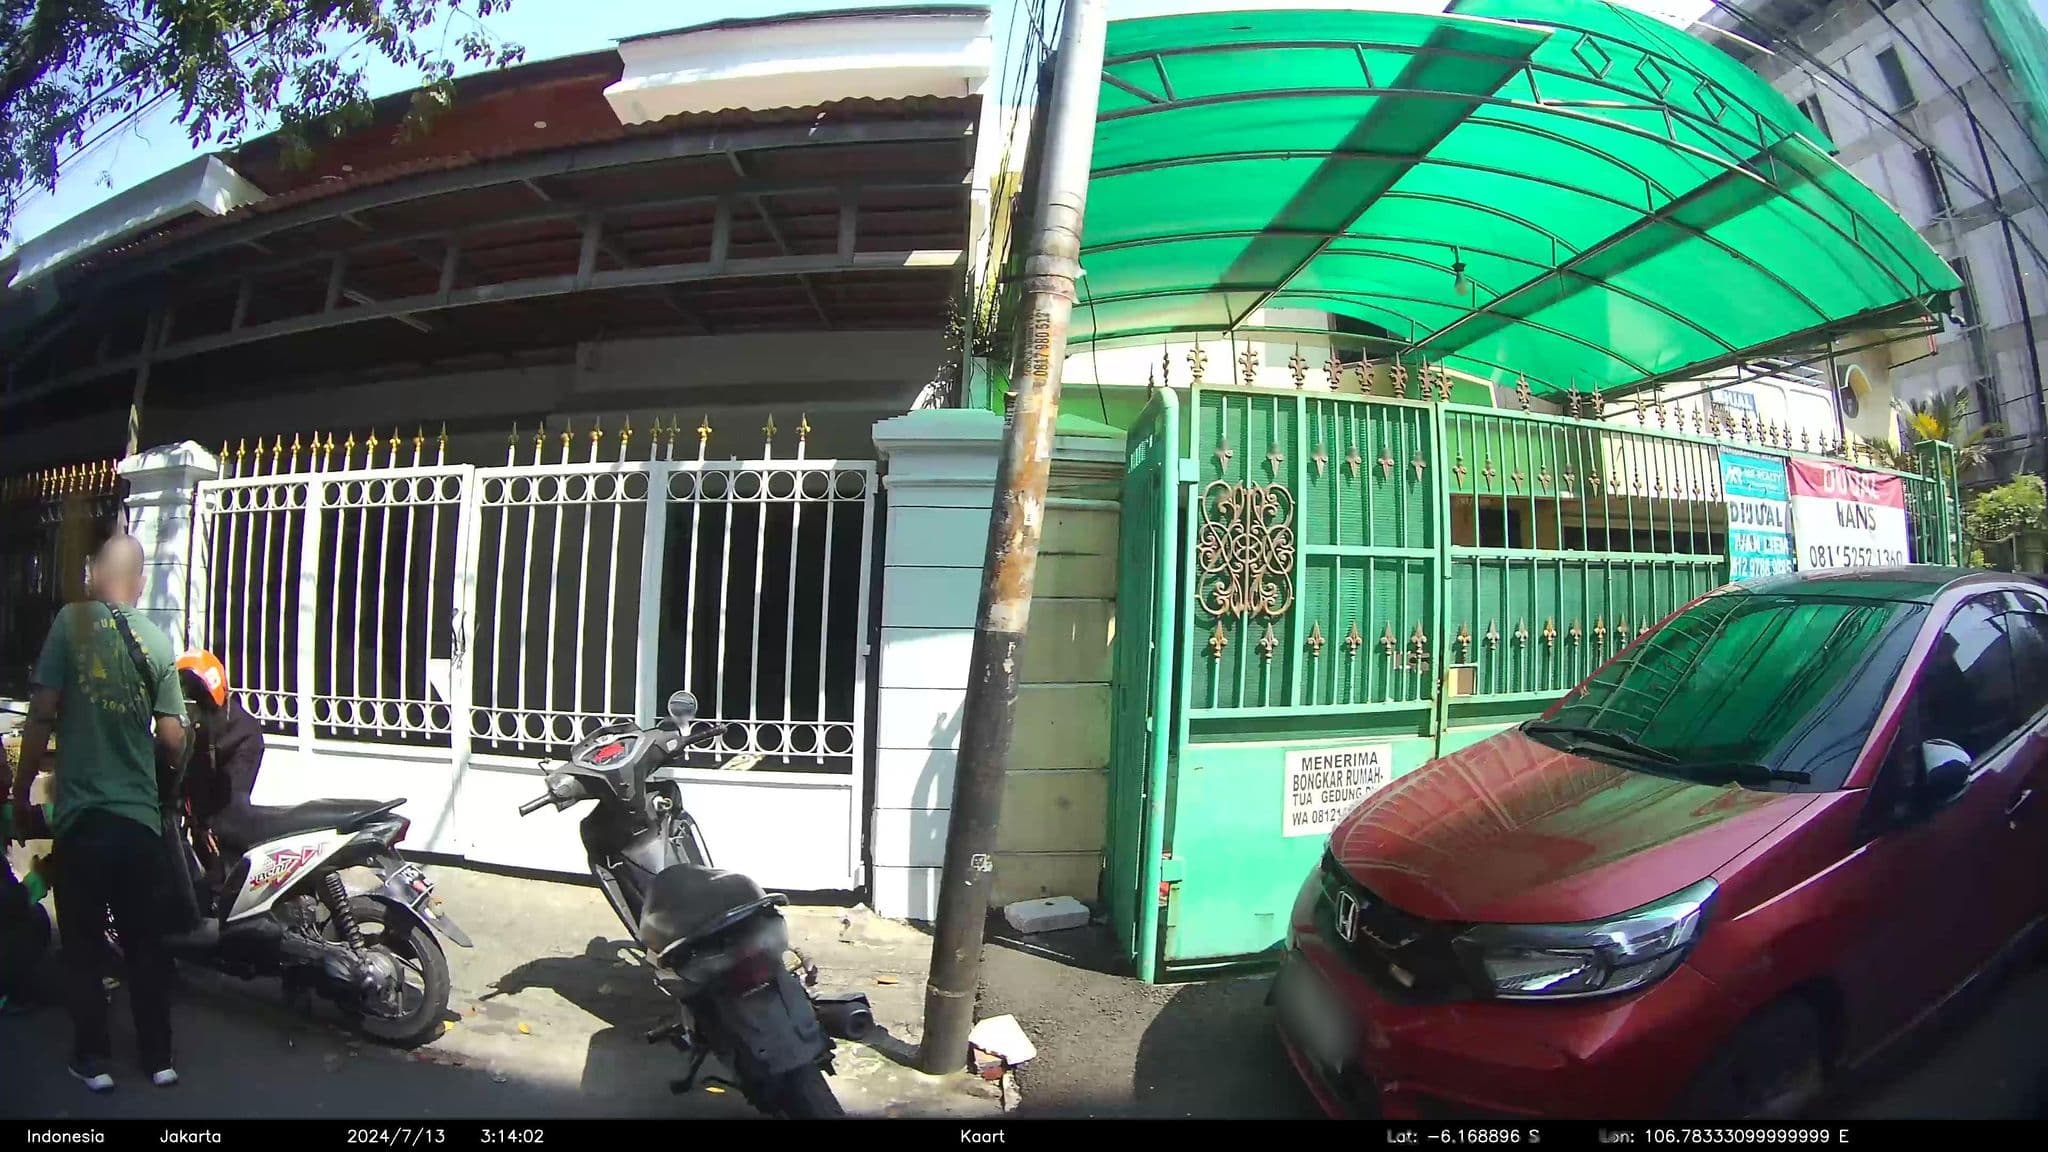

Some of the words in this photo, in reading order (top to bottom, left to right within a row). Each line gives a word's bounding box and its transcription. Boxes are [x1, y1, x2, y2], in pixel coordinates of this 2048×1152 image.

[1730, 502, 1783, 528] DIJUAL
[1301, 751, 1378, 771] MENERIMA
[1293, 770, 1343, 792] BONGKAR
[1293, 793, 1312, 806] TUA
[1321, 787, 1362, 804] GEDUNG
[1293, 811, 1308, 826] WA
